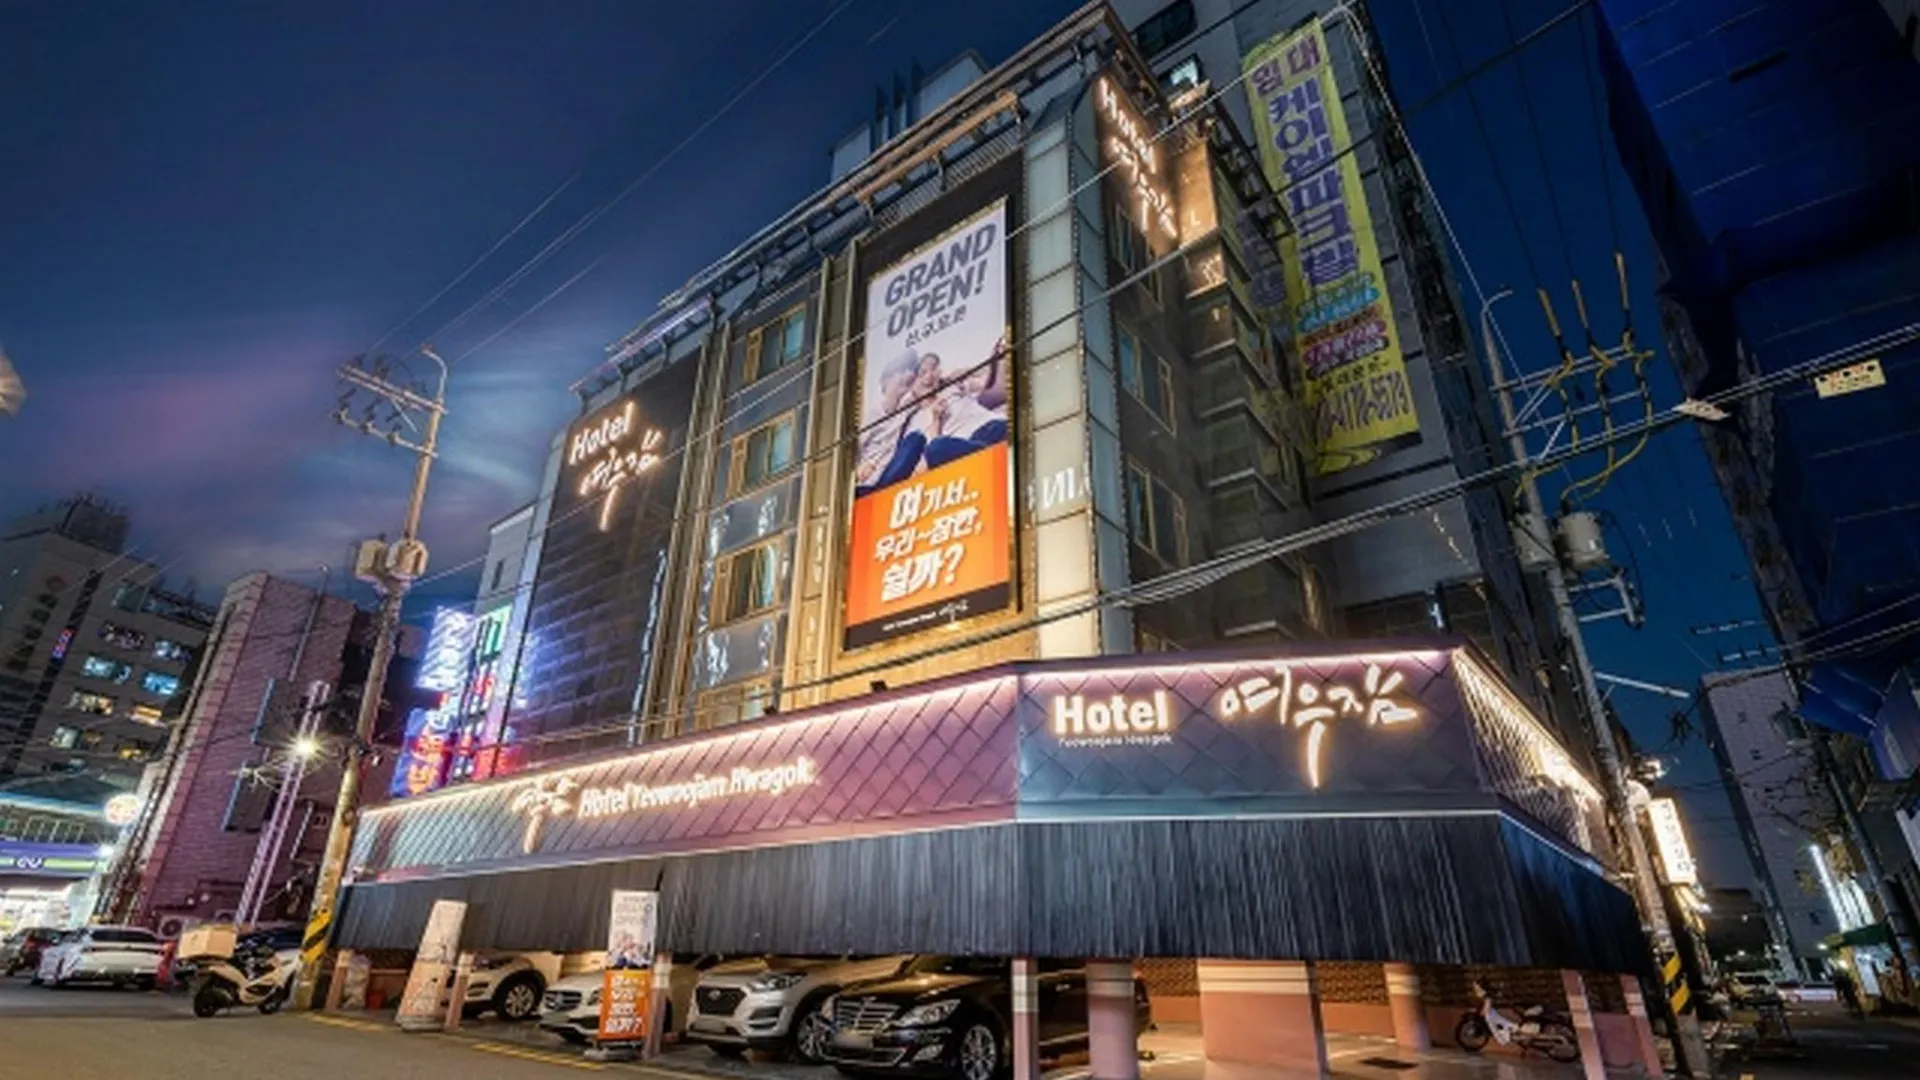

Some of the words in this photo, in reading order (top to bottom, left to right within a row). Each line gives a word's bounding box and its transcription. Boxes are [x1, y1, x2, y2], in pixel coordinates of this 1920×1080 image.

[885, 223, 997, 308] GRAND
[887, 257, 988, 339] OPEN!
[568, 401, 635, 465] Hotel
[889, 477, 980, 529] 여기서..
[1054, 690, 1170, 734] Hotel
[578, 783, 629, 819] Hotel
